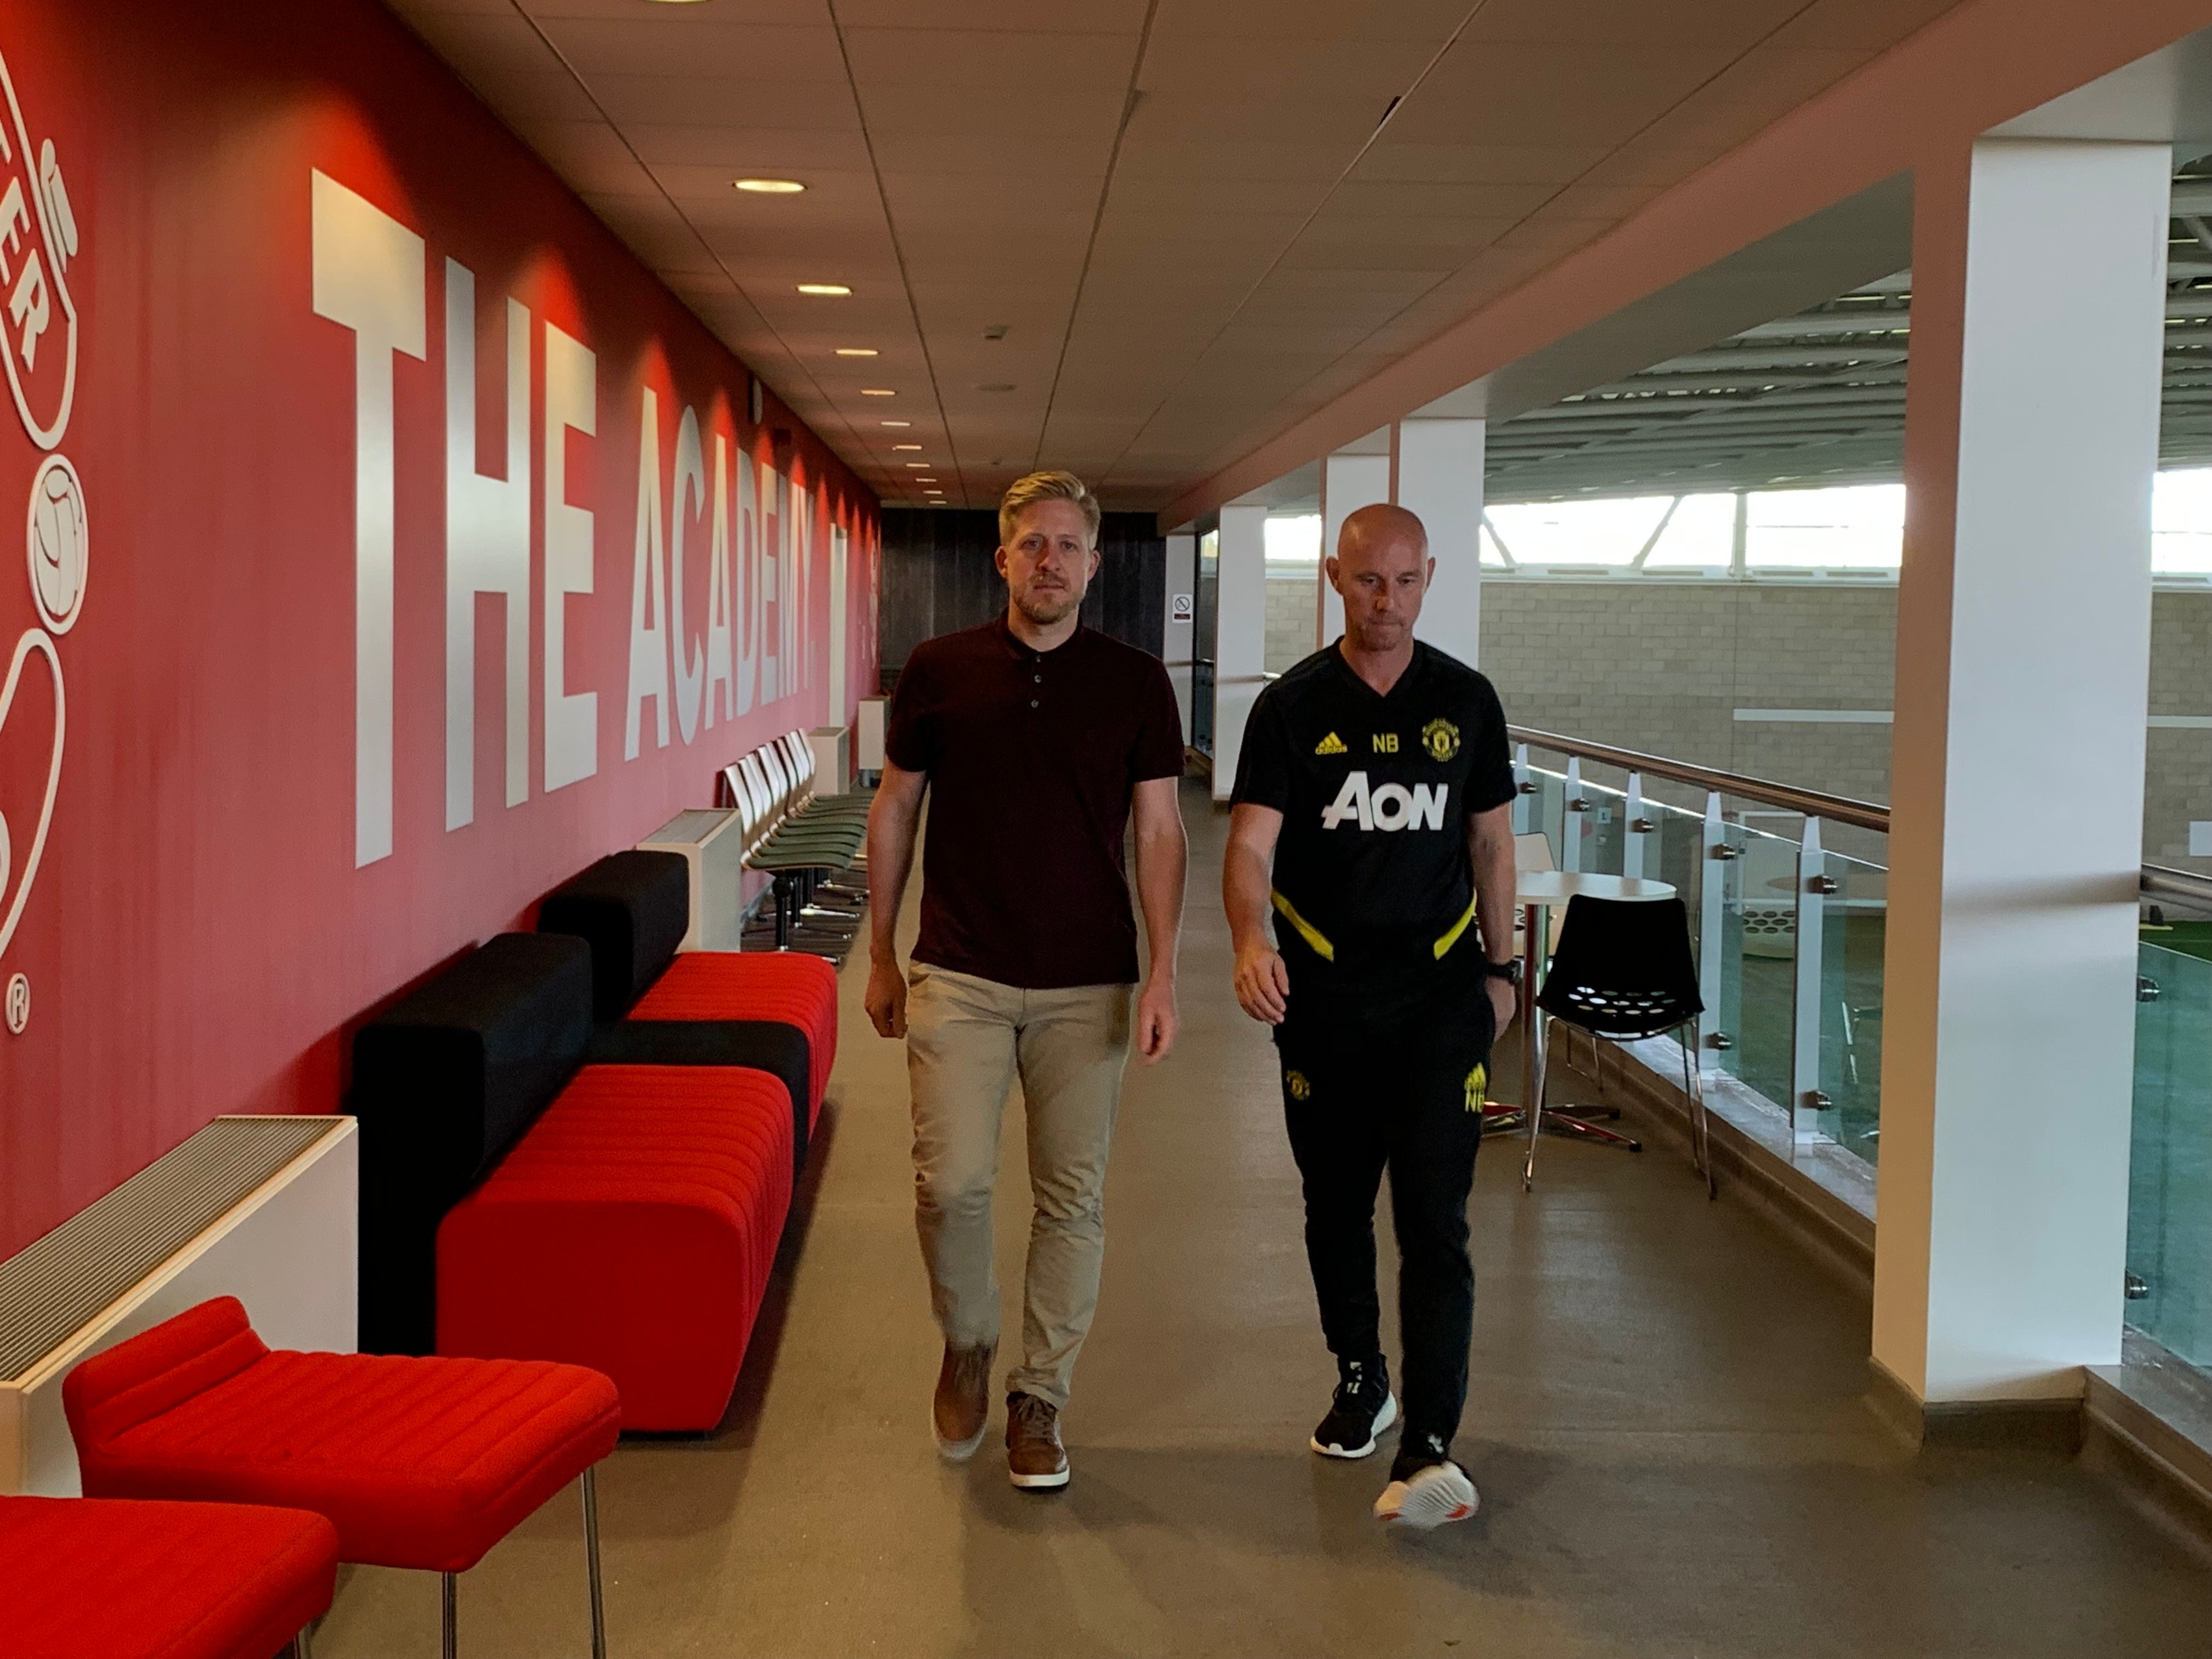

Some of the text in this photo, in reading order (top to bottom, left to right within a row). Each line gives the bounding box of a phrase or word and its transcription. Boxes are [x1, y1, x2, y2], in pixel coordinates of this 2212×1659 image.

[311, 167, 597, 870] THE
[1373, 733, 1399, 753] NB
[1321, 770, 1449, 832] AON
